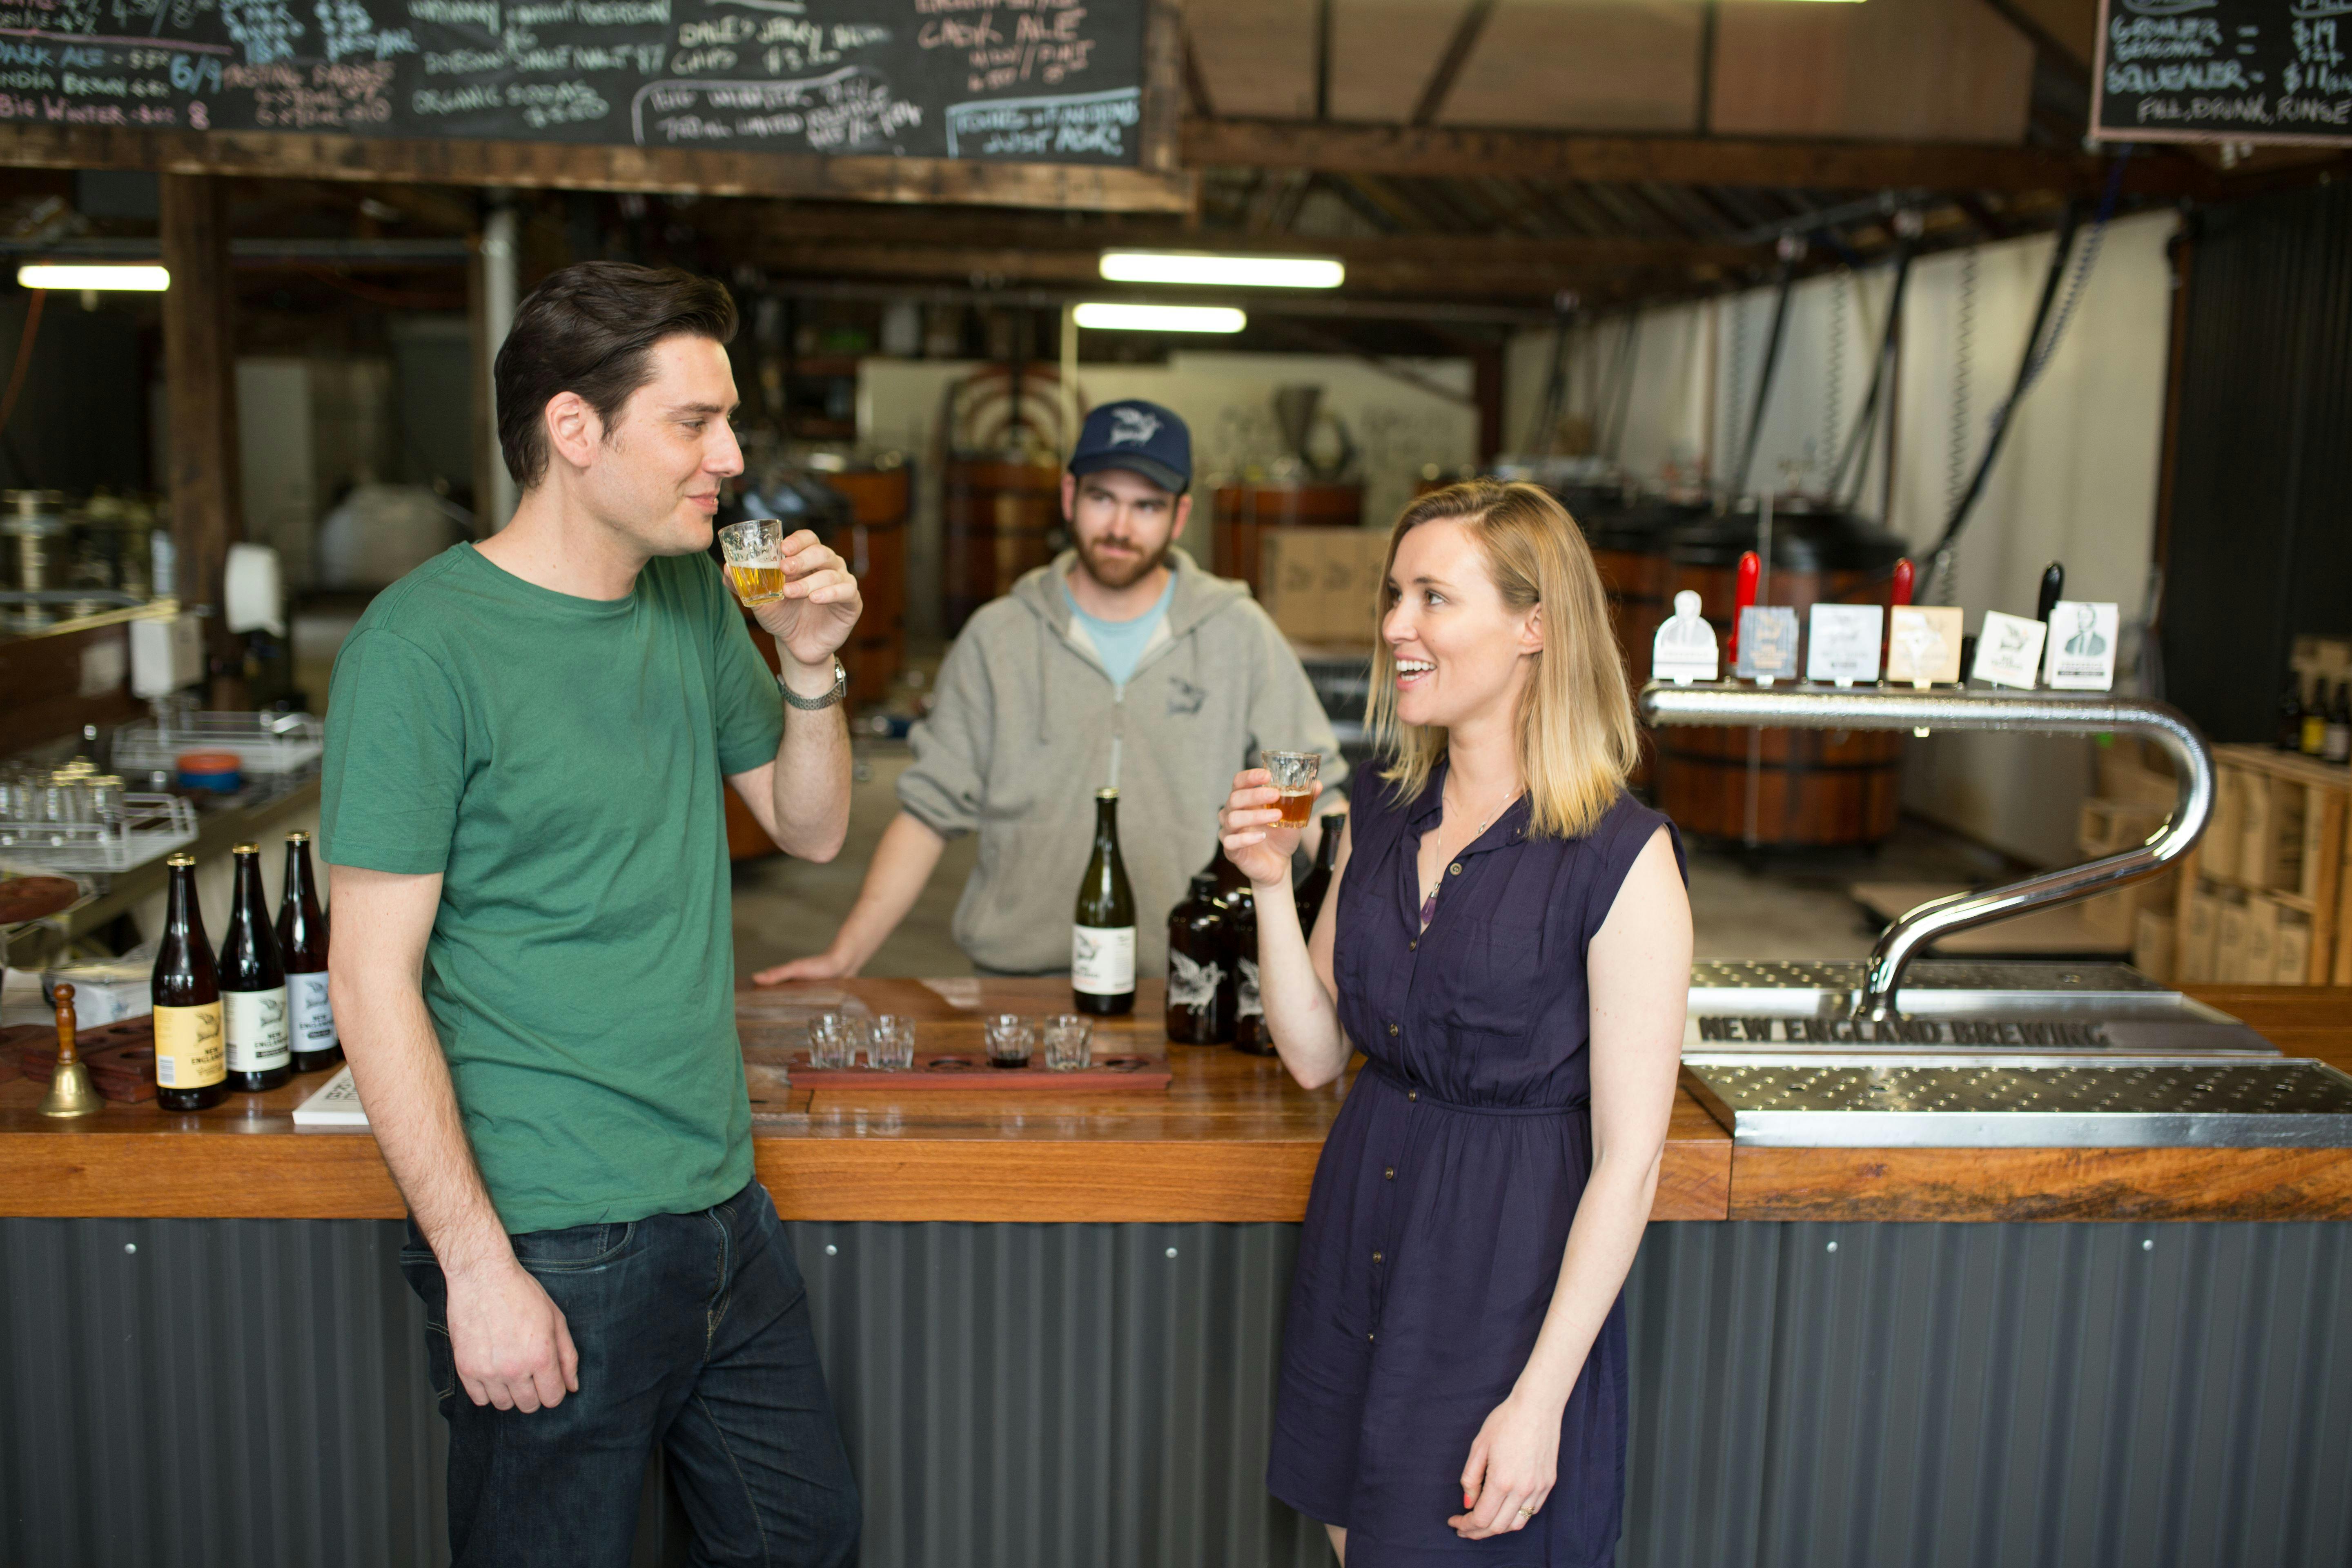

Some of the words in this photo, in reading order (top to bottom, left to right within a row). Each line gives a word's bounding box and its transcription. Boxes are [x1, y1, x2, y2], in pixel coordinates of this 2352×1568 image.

[918, 12, 1004, 49] CASK
[1014, 8, 1088, 42] ALE
[671, 47, 738, 76] CHIPS
[2105, 59, 2250, 96] SQUEALER
[410, 83, 504, 115] ORGANIC
[982, 127, 1056, 155] JUST
[1698, 1016, 1771, 1042] NEW
[1784, 1017, 1943, 1045] ENGLAND
[1951, 1020, 2110, 1048] BREWING
